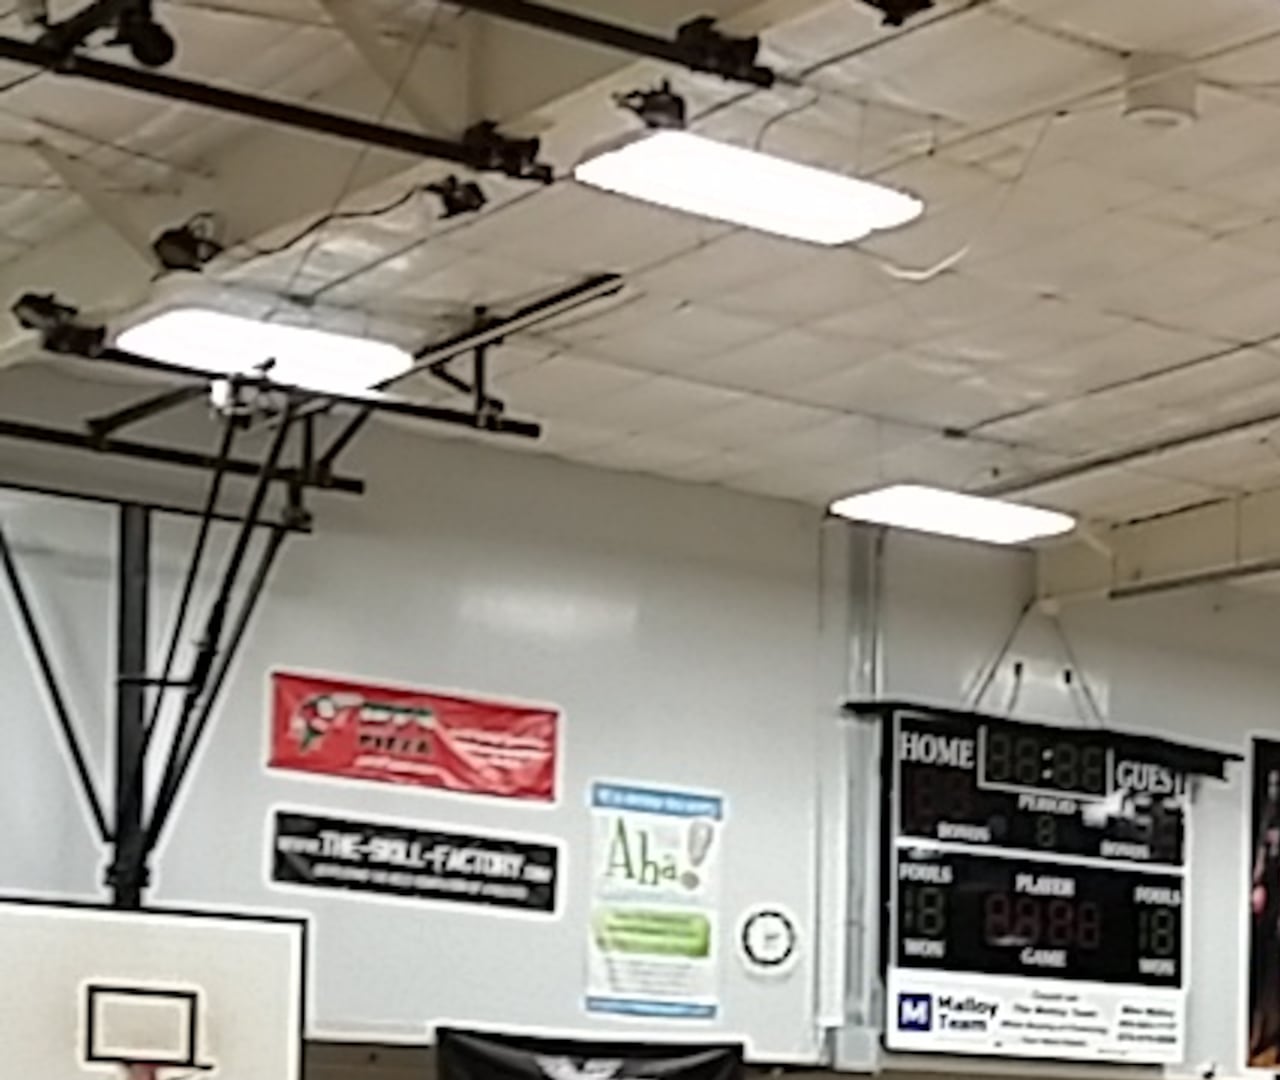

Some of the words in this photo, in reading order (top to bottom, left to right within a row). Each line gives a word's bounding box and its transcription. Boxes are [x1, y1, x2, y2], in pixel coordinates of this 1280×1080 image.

[900, 732, 975, 769] HOME
[1017, 794, 1078, 815] PERIOD
[937, 820, 991, 843] BONUS
[601, 816, 715, 891] Aha!
[899, 862, 953, 884] FOULS
[1015, 873, 1076, 897] PLAYER
[1134, 885, 1182, 907] FOULS
[903, 937, 947, 958] WON
[1019, 946, 1068, 969] GAME
[1138, 957, 1176, 977] WON
[900, 997, 929, 1027] M
[938, 996, 998, 1018] Malloy
[938, 1014, 987, 1032] Team
